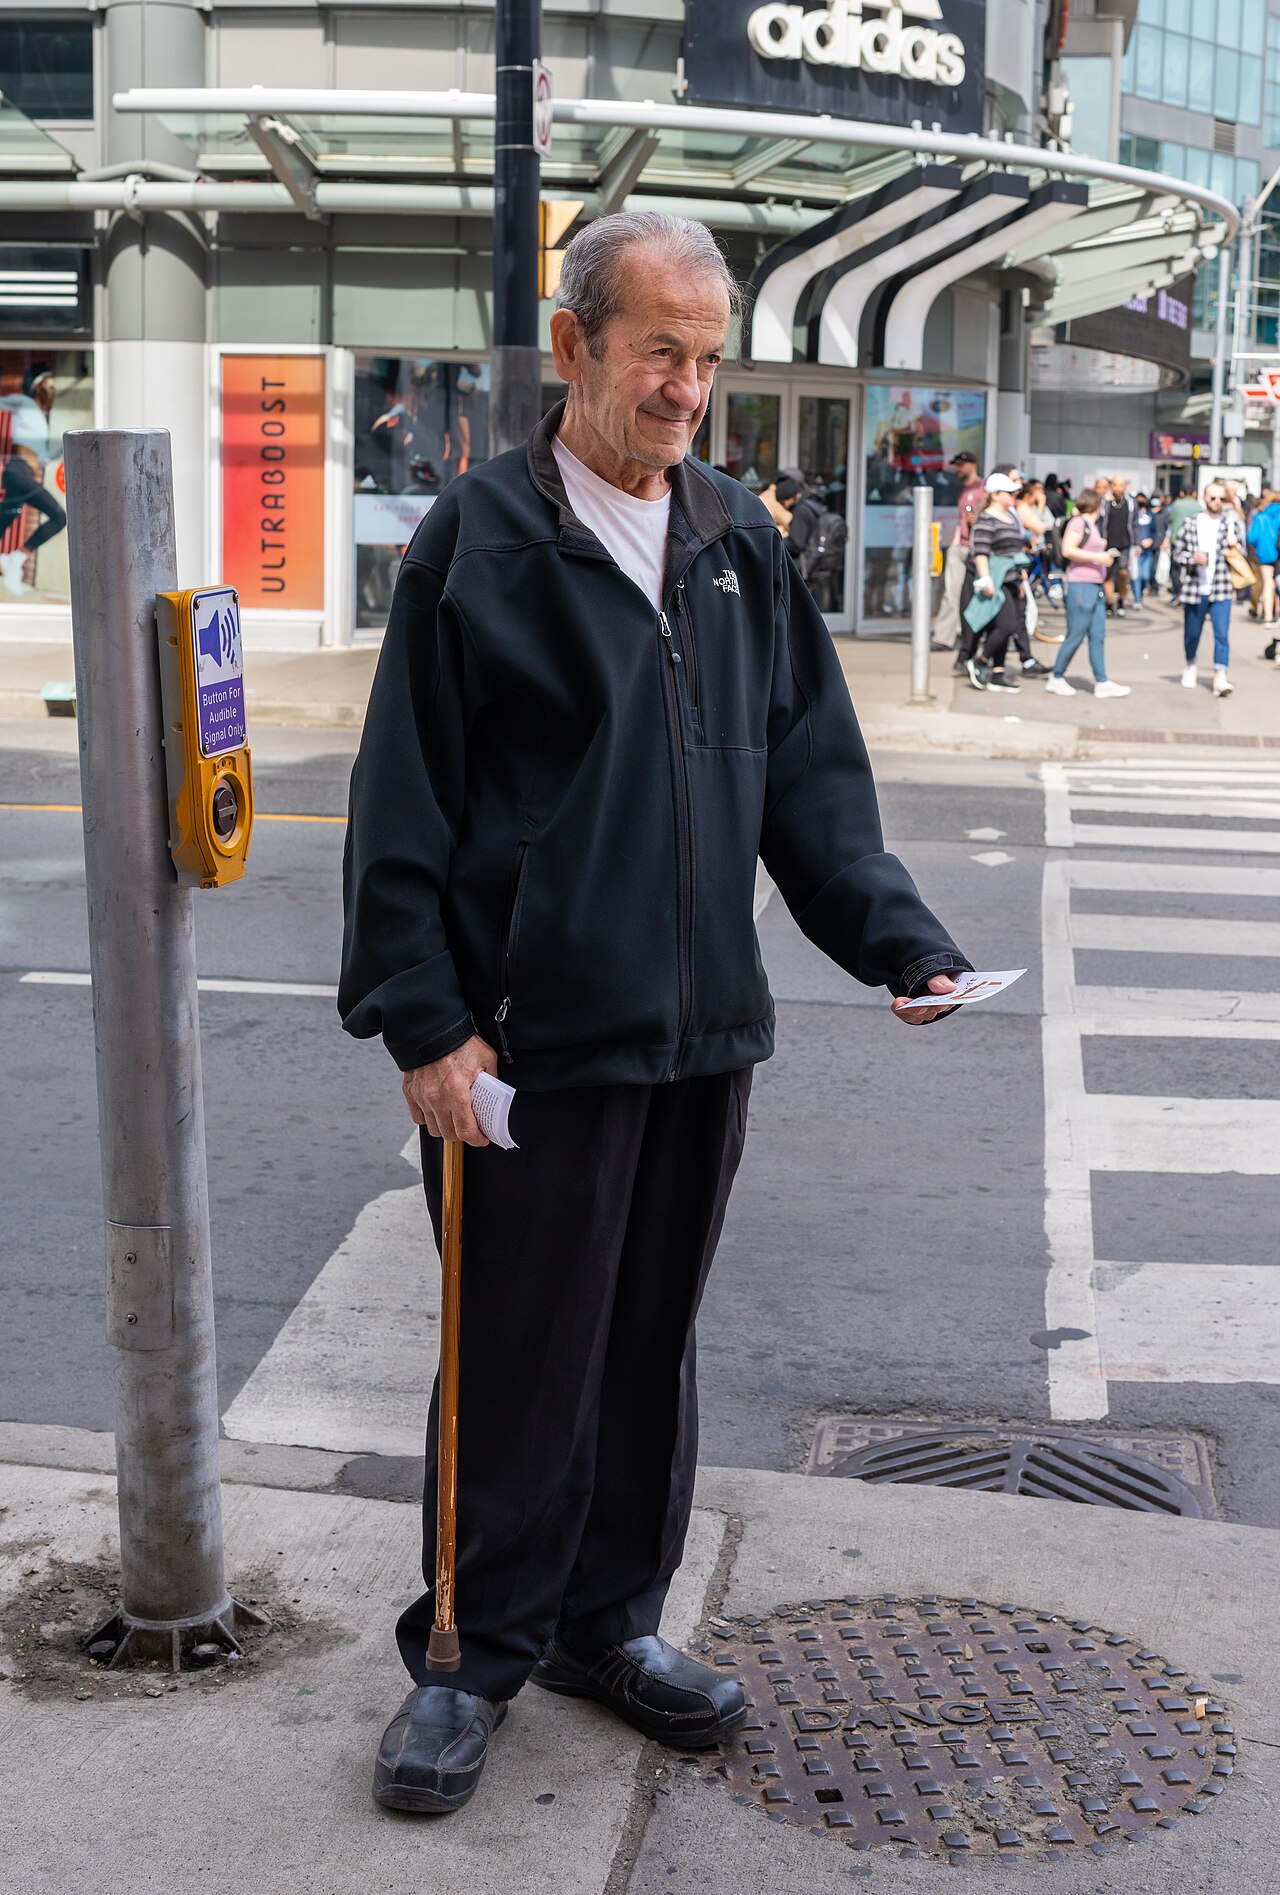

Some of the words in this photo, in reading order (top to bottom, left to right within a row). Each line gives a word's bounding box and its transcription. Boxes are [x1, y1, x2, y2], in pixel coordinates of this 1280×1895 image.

[747, 0, 966, 87] adidas
[261, 377, 286, 593] ULTRABOOST
[202, 691, 228, 706] Button
[228, 687, 240, 700] For
[209, 706, 237, 724] Audible
[204, 727, 227, 745] Signal
[227, 723, 243, 738] Only
[793, 1697, 1083, 1733] DANGER
